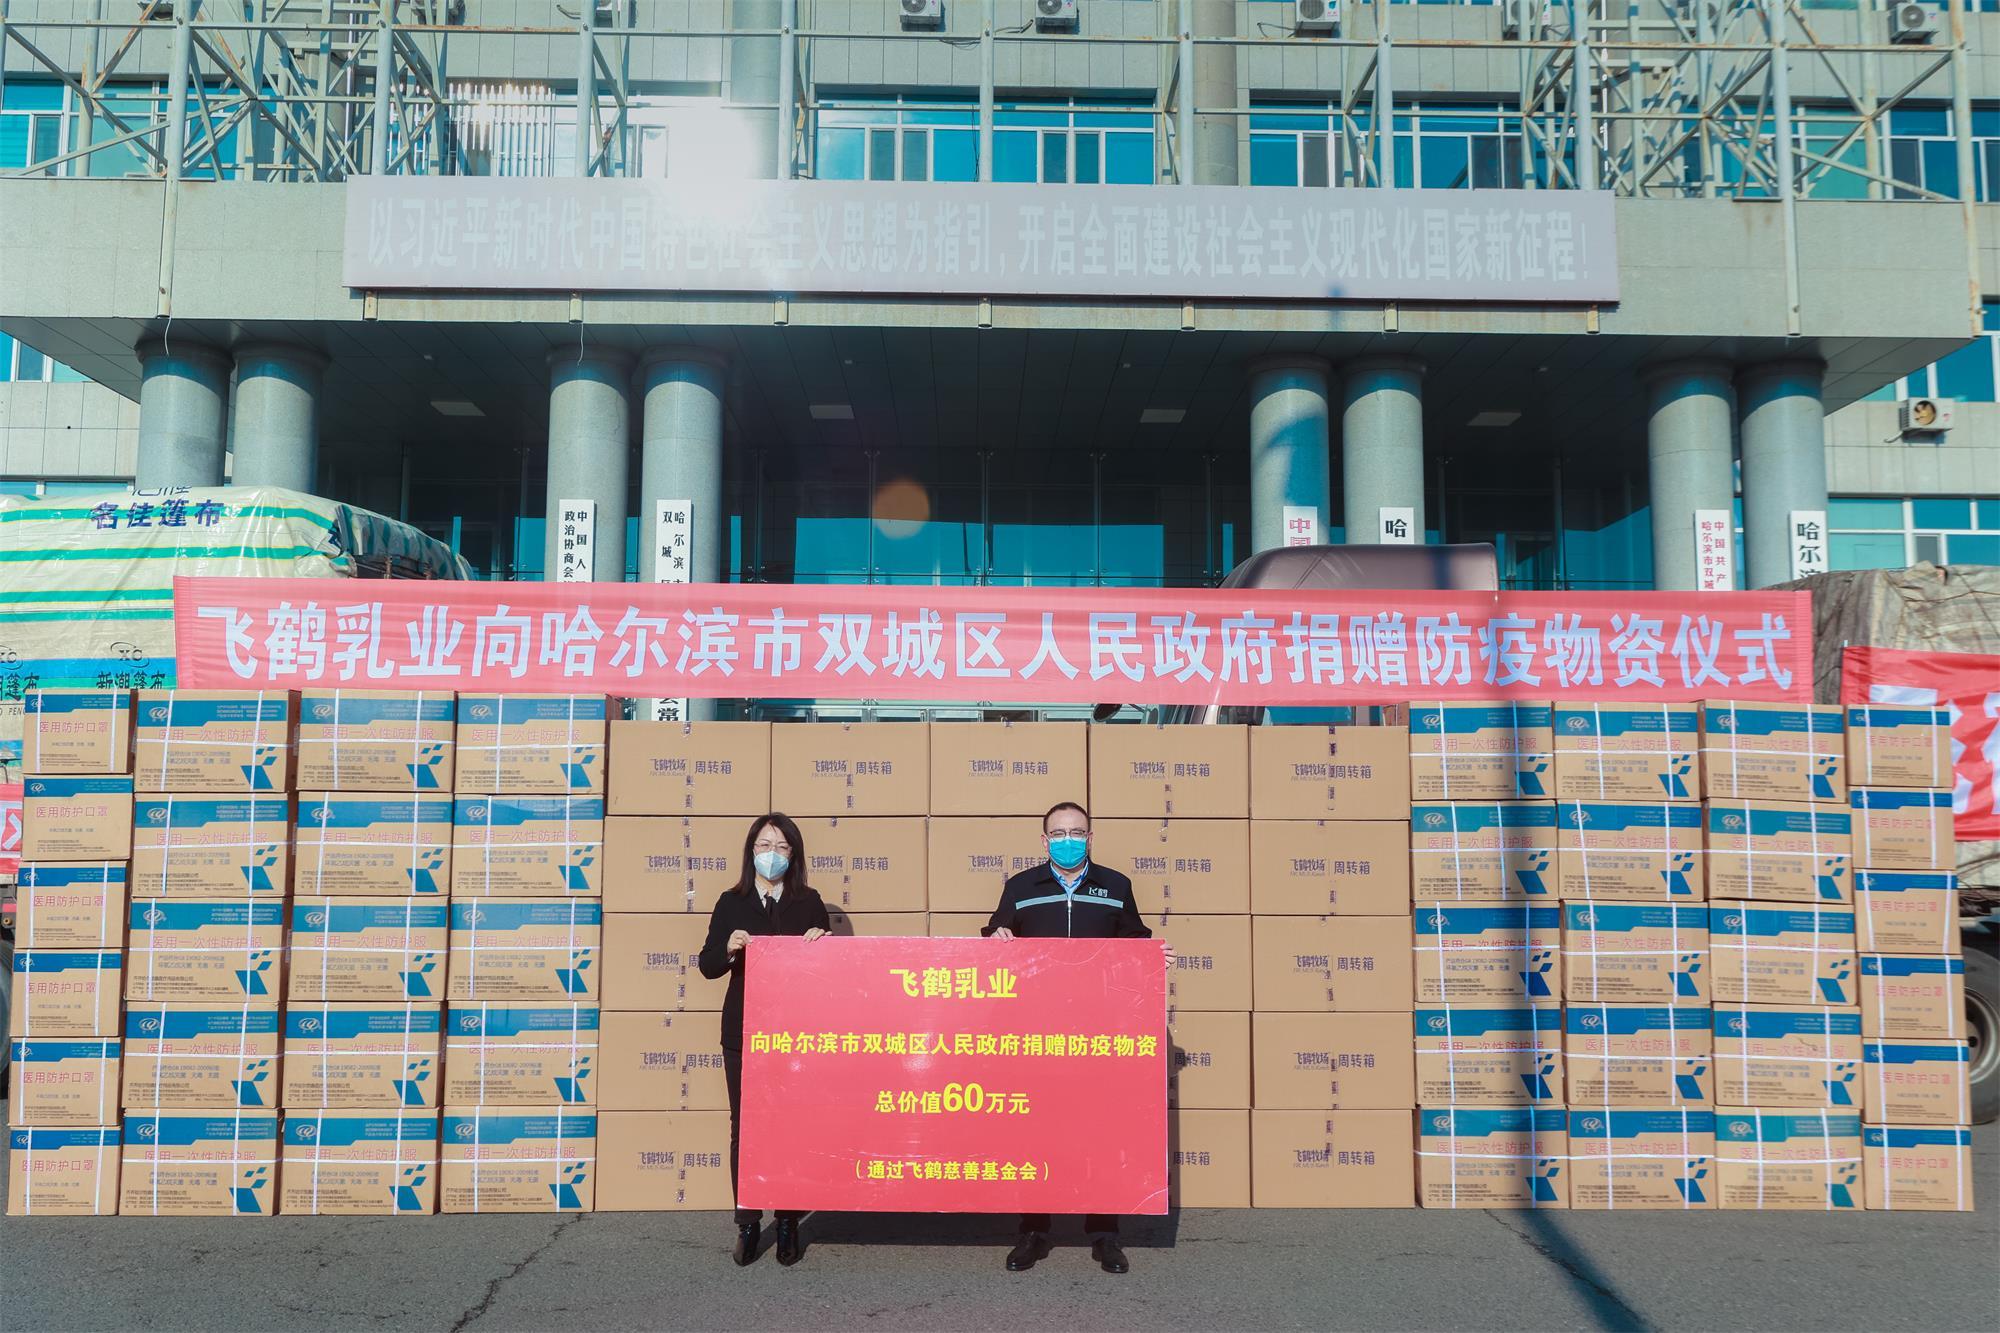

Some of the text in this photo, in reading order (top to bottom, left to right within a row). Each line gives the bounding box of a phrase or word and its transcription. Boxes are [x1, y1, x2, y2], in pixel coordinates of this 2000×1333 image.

[1385, 518, 1407, 538] 哈
[563, 511, 575, 583] 政治协商会
[576, 511, 588, 583] 中国人
[661, 512, 673, 583] 双城
[197, 601, 1792, 691] 飞鹤乳业向哈尔滨市双城区人民政府捐赠防疫物资仪式
[695, 761, 732, 774] 周转箱
[855, 762, 892, 775] 周转箱
[1012, 761, 1049, 776] 周转箱
[1173, 763, 1210, 777] 周转箱
[1335, 765, 1372, 779] 周转箱
[36, 806, 107, 817] 医用防护口罩
[689, 857, 727, 871] 周转箱
[852, 857, 889, 871] 周转箱
[1174, 859, 1211, 873] 周转箱
[1333, 860, 1370, 874] 周转箱
[33, 895, 104, 907] 医用防护口罩
[1176, 956, 1213, 970] 周转箱
[1337, 957, 1374, 971] 周转箱
[890, 967, 1018, 999] 飞鹤乳业
[751, 1031, 1157, 1058] 向哈尔滨市双城区人民政府捐赠防疫物资
[685, 1054, 723, 1068] 周转箱
[1174, 1052, 1211, 1066] 周转箱
[1338, 1054, 1375, 1068] 周转箱
[23, 1072, 94, 1084] 医用防护口罩
[875, 1083, 1030, 1114] 总价值60万元
[683, 1153, 721, 1167] 周转箱
[1173, 1151, 1210, 1165] 周转箱
[1338, 1151, 1375, 1165] 周转箱
[856, 1160, 1049, 1181] （通过飞鹤慈善基金会）
